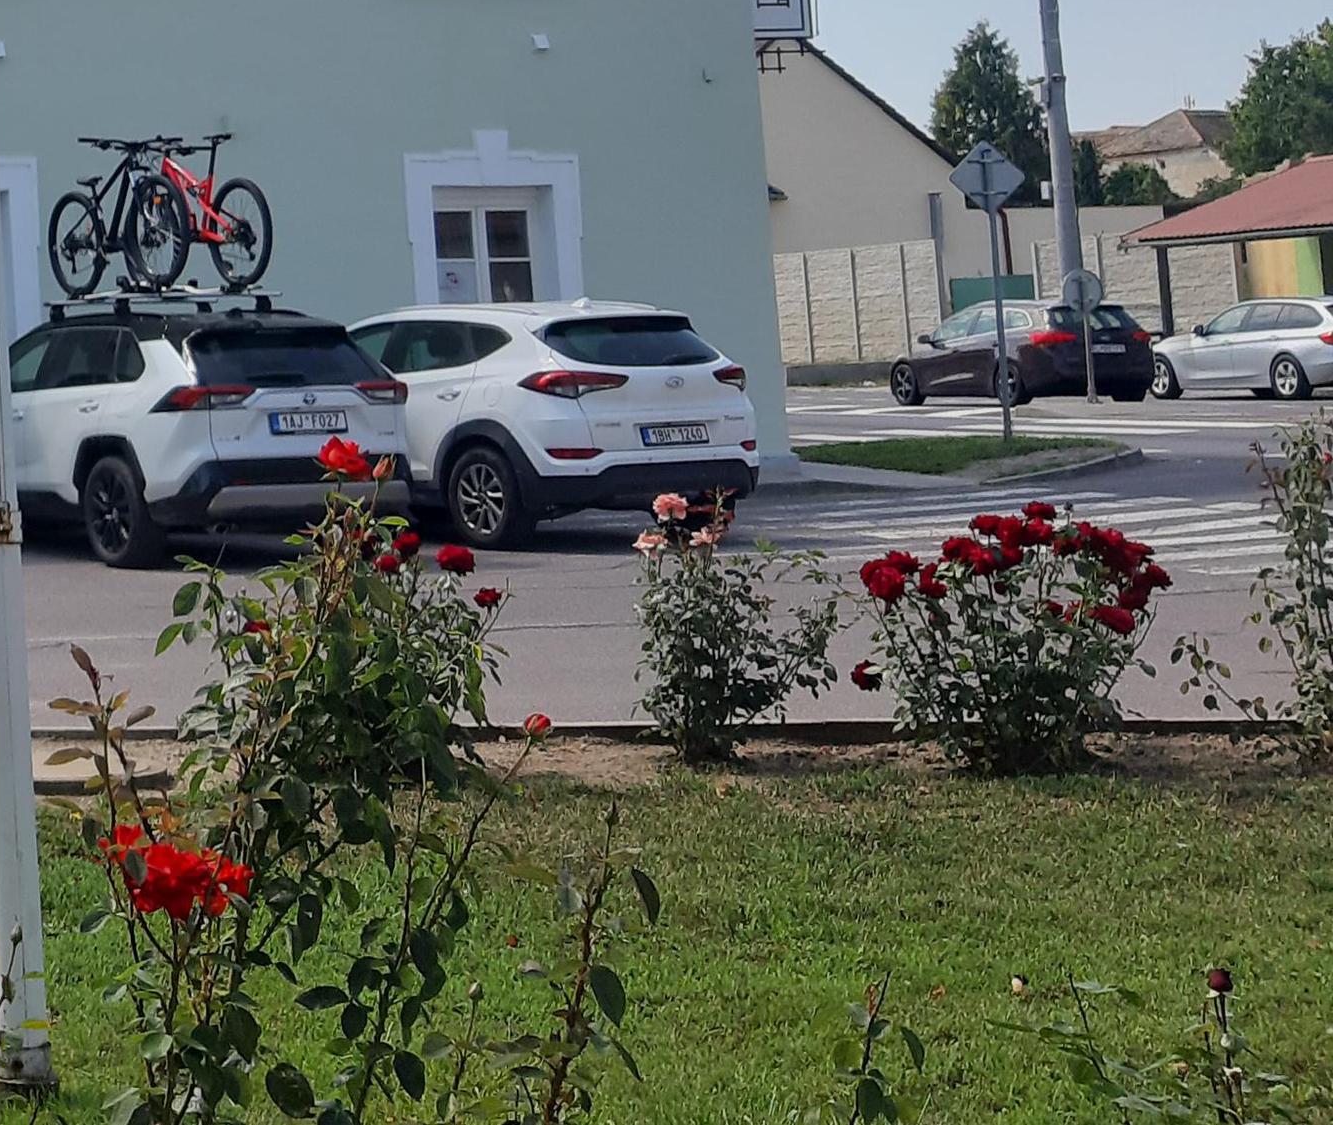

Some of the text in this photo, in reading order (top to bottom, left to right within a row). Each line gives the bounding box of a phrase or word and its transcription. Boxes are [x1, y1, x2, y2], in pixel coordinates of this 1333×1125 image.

[282, 413, 341, 429] 1AJ F027
[652, 427, 703, 443] 1BH 1240
